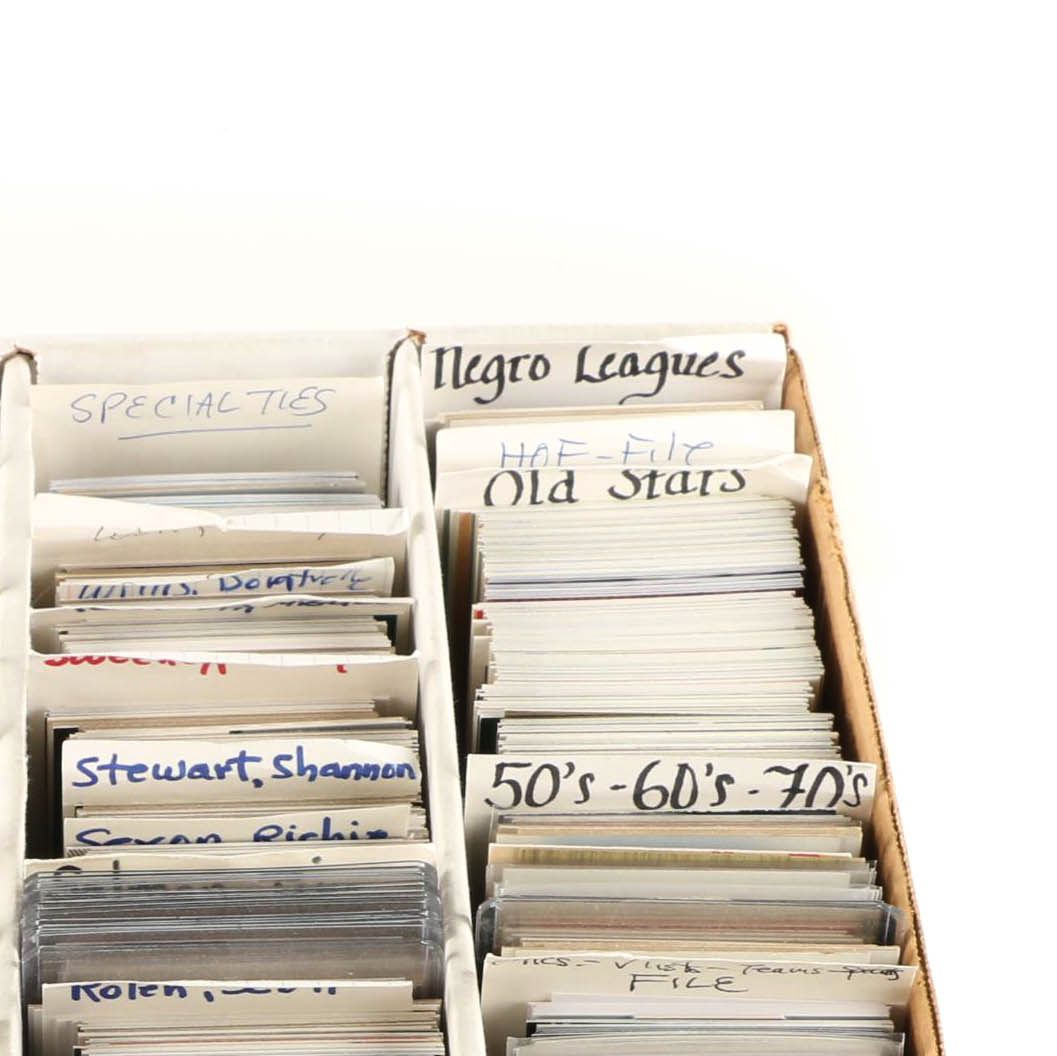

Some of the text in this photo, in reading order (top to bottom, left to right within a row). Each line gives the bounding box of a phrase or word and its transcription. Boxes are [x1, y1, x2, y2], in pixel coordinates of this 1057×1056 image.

[430, 344, 747, 406] Negro Leagues
[483, 467, 752, 507] Old Stars
[271, 745, 418, 783] Shannon
[629, 973, 751, 993] FILE
